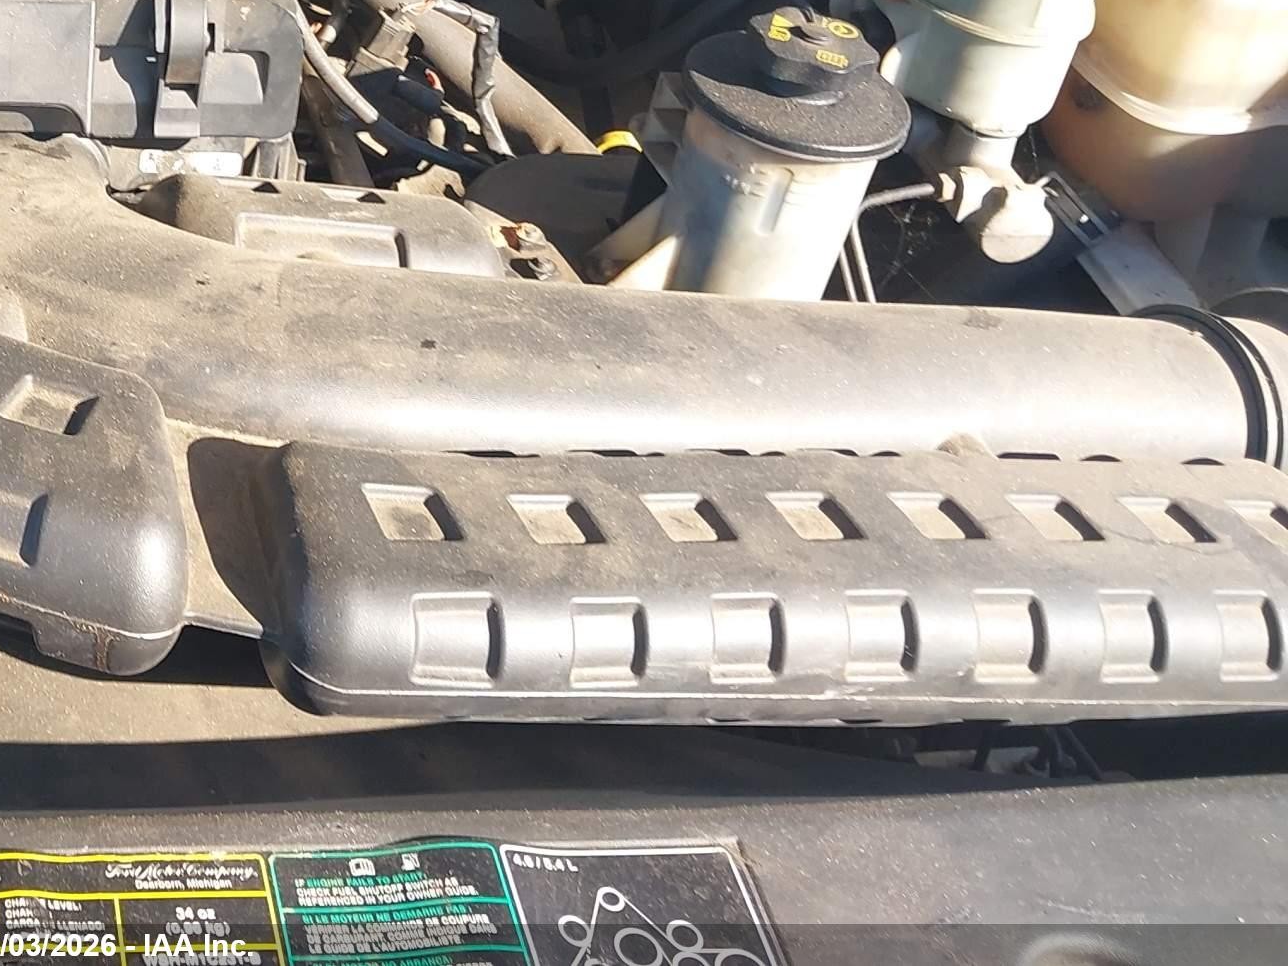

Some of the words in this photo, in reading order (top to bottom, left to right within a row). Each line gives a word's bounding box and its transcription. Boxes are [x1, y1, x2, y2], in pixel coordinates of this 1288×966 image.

[186, 878, 233, 890] Michigan
[296, 887, 331, 898] CHECK
[332, 886, 359, 897] FUEL
[358, 882, 404, 895] SHUTOFF
[404, 878, 444, 891] SWITCH
[444, 876, 460, 887] AS
[306, 877, 344, 888] ENGINE
[346, 876, 375, 887] FAILS
[375, 875, 391, 885] TO
[298, 895, 365, 907] REFERENCED
[365, 894, 376, 904] IN
[377, 892, 406, 904] YOUR
[406, 887, 444, 902] OWNER
[175, 906, 195, 921] 34
[315, 913, 329, 924] LE
[330, 912, 375, 924] MOTEUR
[376, 911, 391, 922] NE
[440, 914, 491, 926] COUPURE
[323, 942, 355, 954] GUIDE
